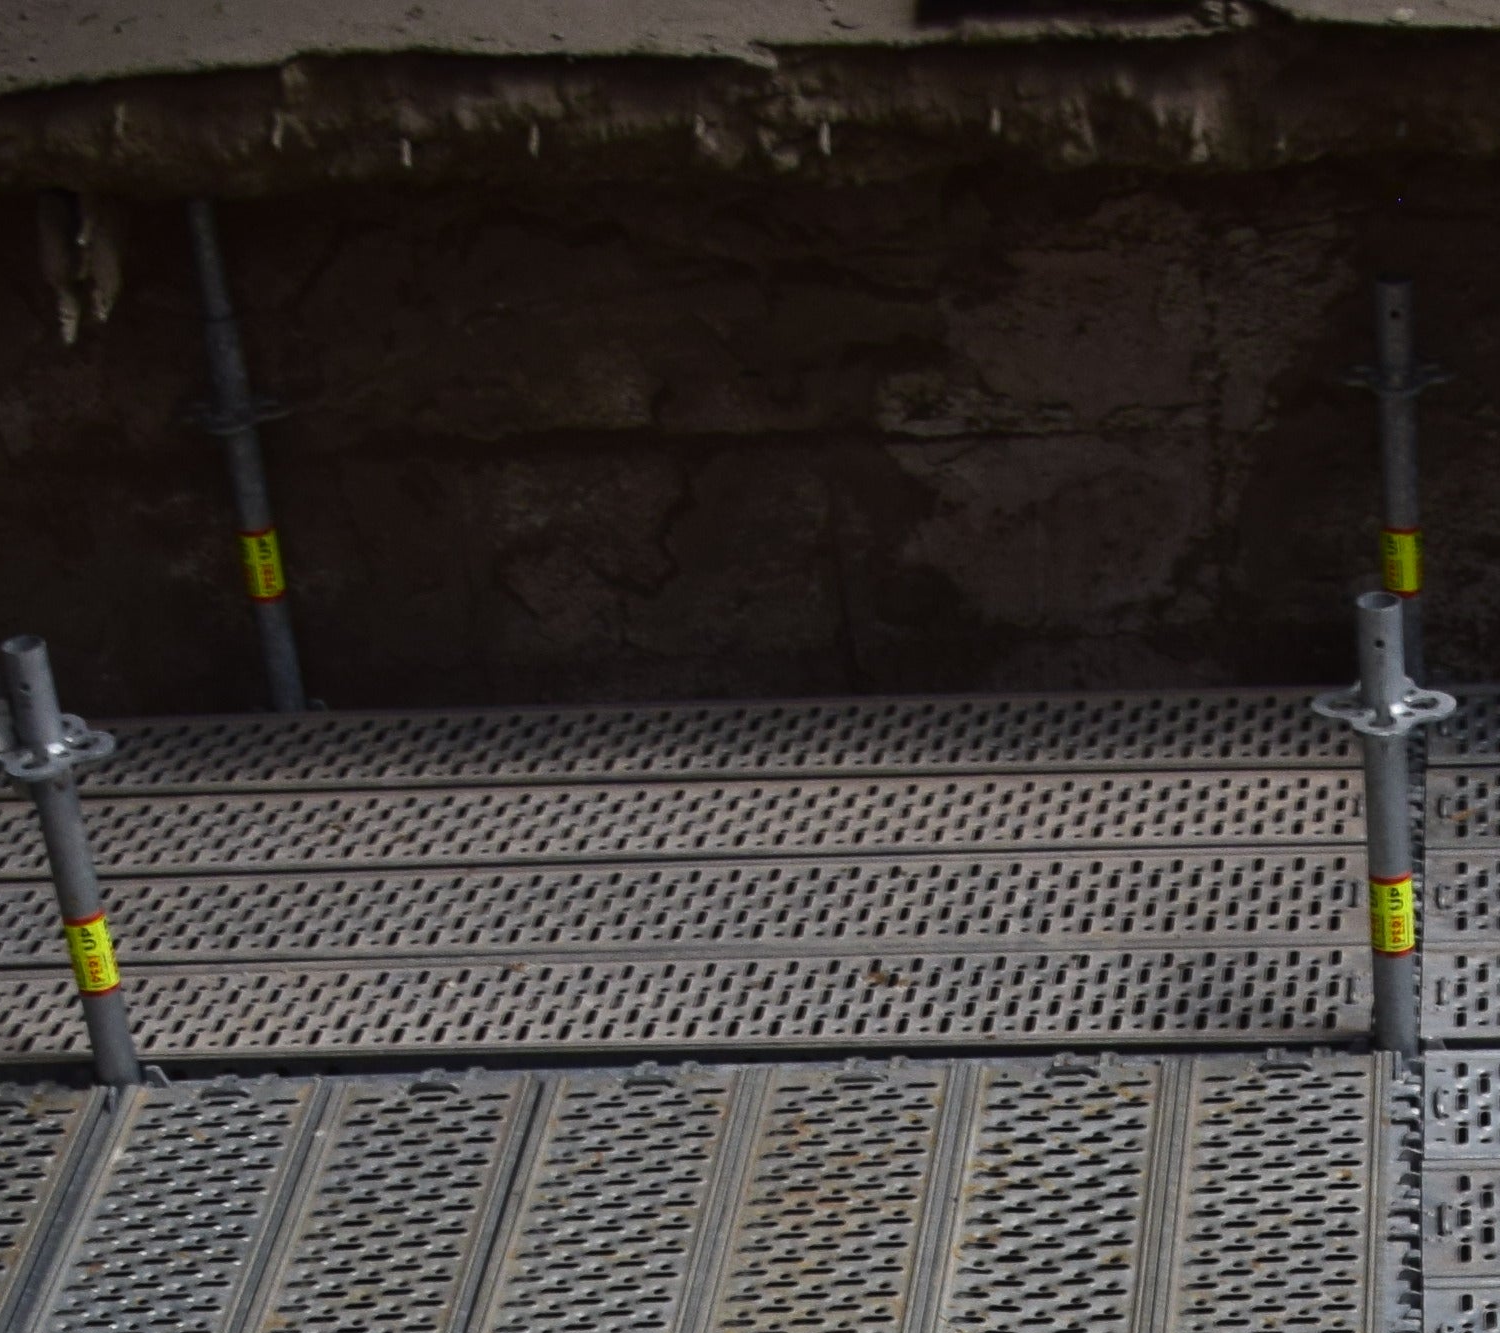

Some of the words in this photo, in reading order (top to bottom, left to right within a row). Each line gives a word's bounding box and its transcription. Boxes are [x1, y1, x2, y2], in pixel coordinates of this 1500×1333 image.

[1389, 887, 1404, 911] UP
[80, 927, 97, 951] UP
[1390, 915, 1406, 944] PERI
[86, 955, 106, 984] PERI
